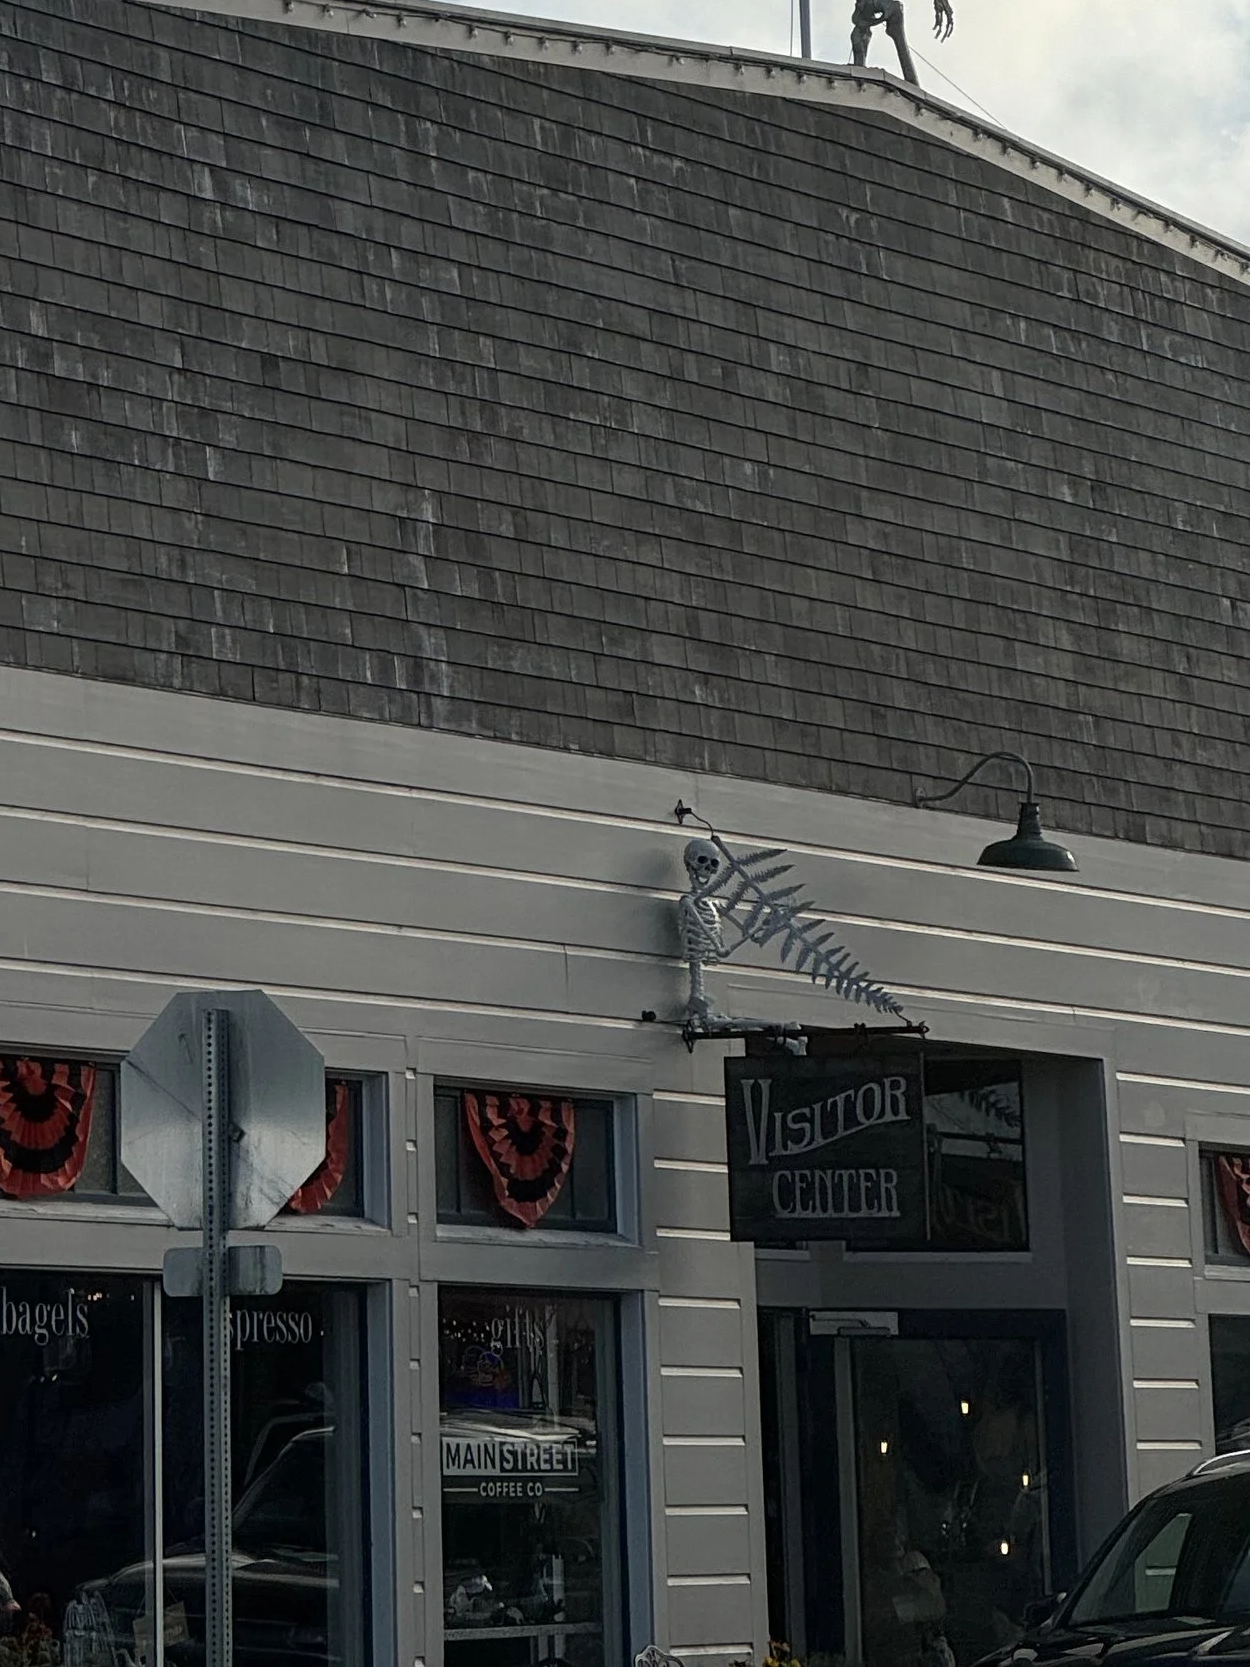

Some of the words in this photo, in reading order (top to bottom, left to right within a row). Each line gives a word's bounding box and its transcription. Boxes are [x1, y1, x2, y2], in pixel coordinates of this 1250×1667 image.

[740, 1076, 911, 1165] VISITOR
[772, 1168, 900, 1218] CENTER
[1, 1287, 89, 1345] bagels
[229, 1309, 313, 1351] presso
[446, 1443, 496, 1470] MAIN
[502, 1443, 575, 1470] STREET
[479, 1481, 524, 1497] COFFEE
[526, 1481, 543, 1496] CO
